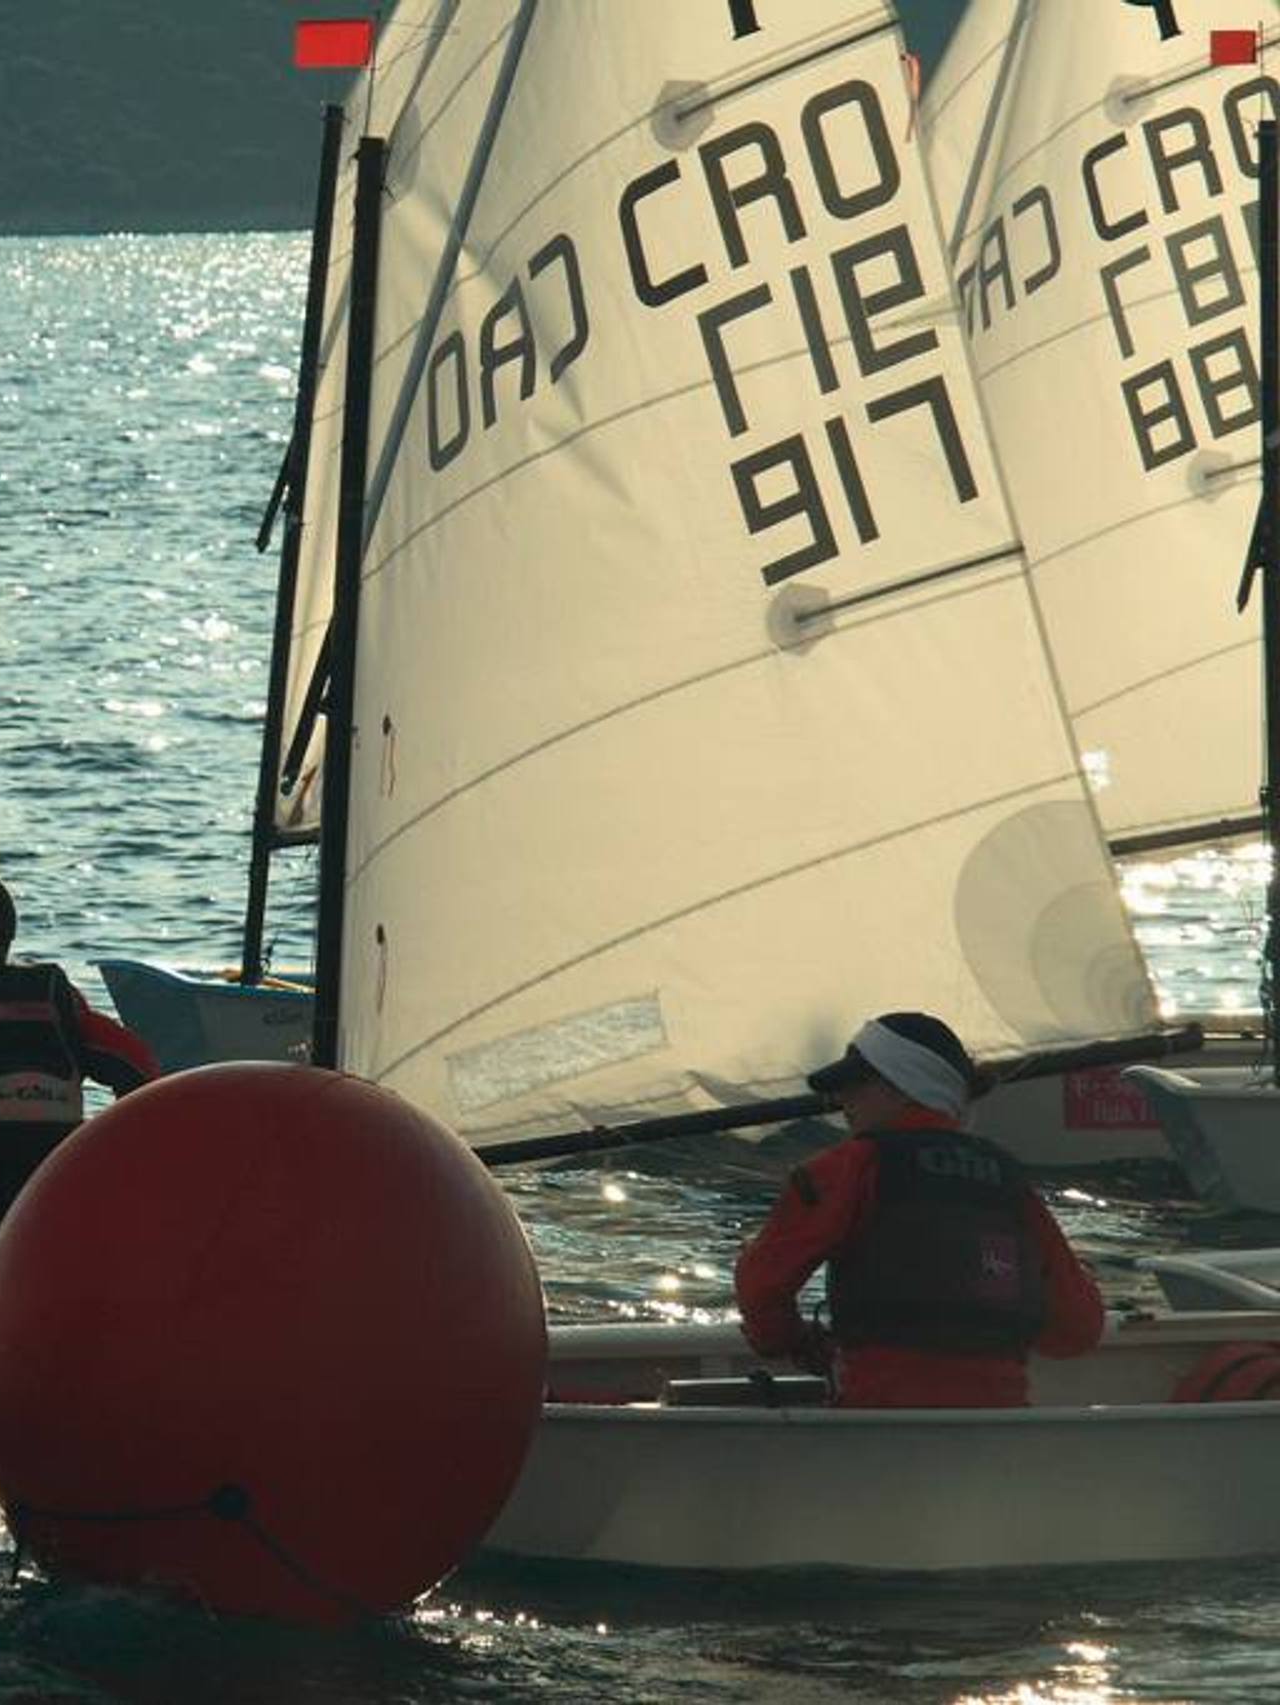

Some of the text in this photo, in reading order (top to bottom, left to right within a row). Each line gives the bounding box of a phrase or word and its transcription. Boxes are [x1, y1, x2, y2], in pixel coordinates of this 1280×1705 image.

[618, 79, 901, 307] CRO
[1082, 76, 1280, 242] CRO
[730, 375, 979, 586] 917
